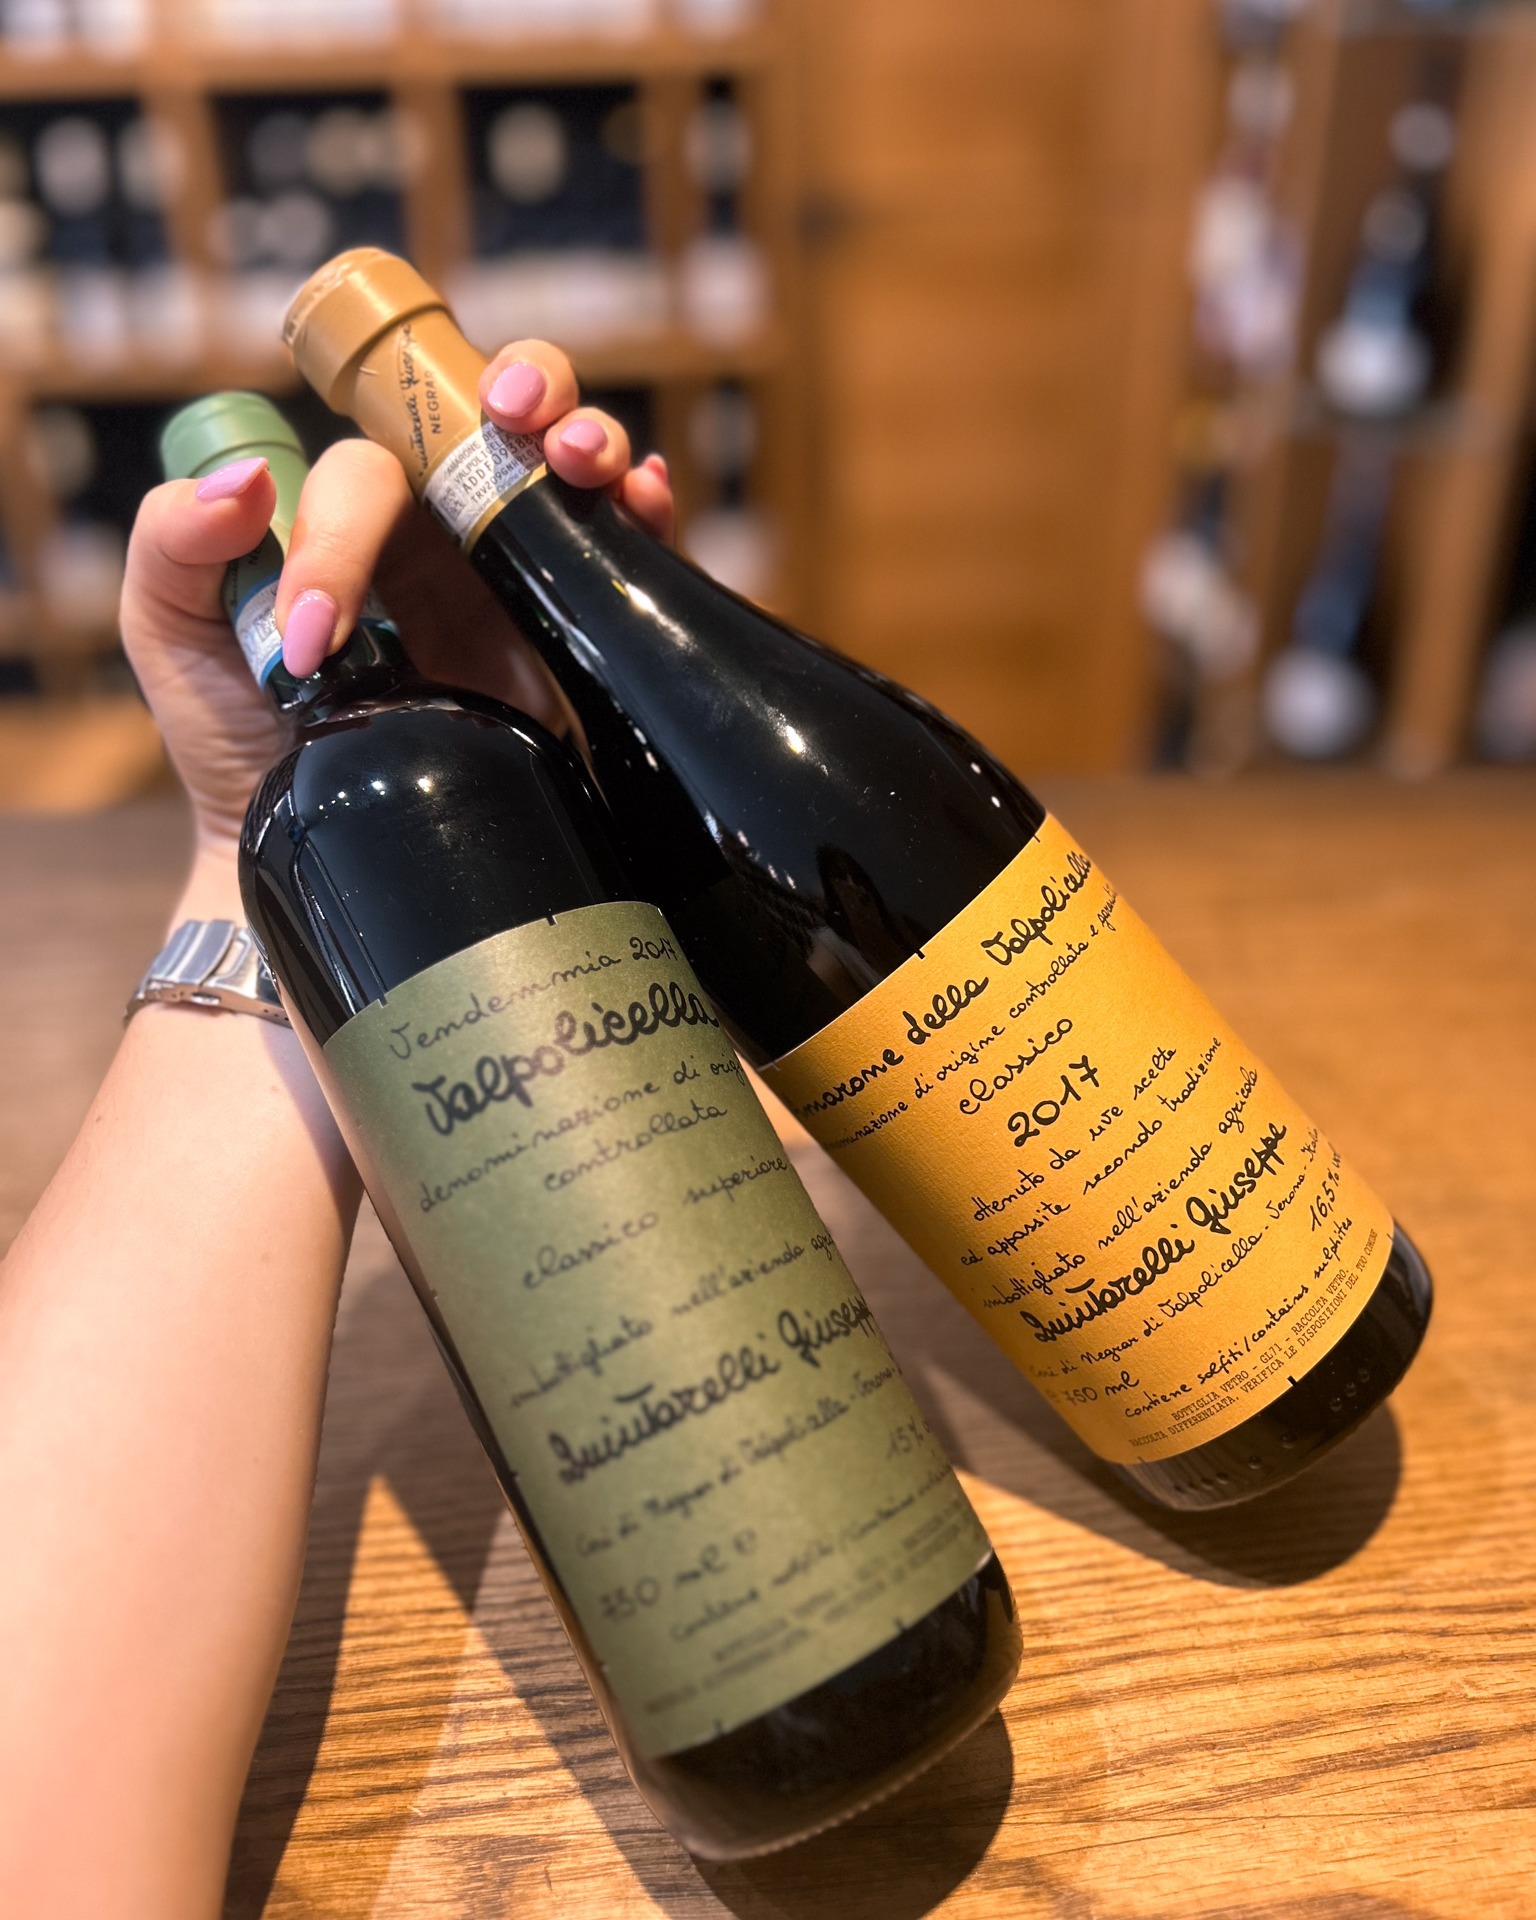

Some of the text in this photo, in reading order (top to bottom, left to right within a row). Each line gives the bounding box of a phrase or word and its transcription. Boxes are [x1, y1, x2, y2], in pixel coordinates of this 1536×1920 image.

[389, 936, 678, 1060] Vendemmia 2017
[796, 851, 1091, 1117] marone della Valpolicella
[915, 1073, 934, 1099] di
[936, 1025, 1005, 1081] origine
[1009, 941, 1089, 1019] controllata
[411, 981, 720, 1136] Valpolicella
[673, 1055, 701, 1085] di
[959, 1018, 1073, 1115] classico
[1007, 1054, 1100, 1148] 2017
[544, 1099, 728, 1192] controllata
[683, 1156, 787, 1205] superiore
[961, 1037, 1222, 1266] ed appassite secondo tradizione
[971, 1168, 1045, 1222] ottenuto
[1049, 1148, 1081, 1170] da
[1089, 1106, 1124, 1142] uve
[1098, 1141, 1213, 1250] nell'azienda
[1218, 1066, 1258, 1134] agricola
[1186, 1122, 1288, 1234] Giuseppe
[1081, 1336, 1139, 1364] Negrar
[1143, 1316, 1164, 1337] di
[1157, 1232, 1263, 1318] Valpolicella
[1265, 1174, 1305, 1220] Verona
[777, 1297, 876, 1368] Giusepp
[1105, 1370, 1140, 1397] ml
[1171, 1391, 1221, 1422] BOTTIGLIA
[1219, 1370, 1250, 1394] VETRO
[1259, 1342, 1283, 1365] GL71
[1290, 1295, 1329, 1337] RACCOLTA
[1240, 1357, 1285, 1394] VERIFICA
[1283, 1345, 1298, 1361] LE
[1296, 1289, 1348, 1347] DISPOSIZIONI
[1346, 1273, 1360, 1291] DEL
